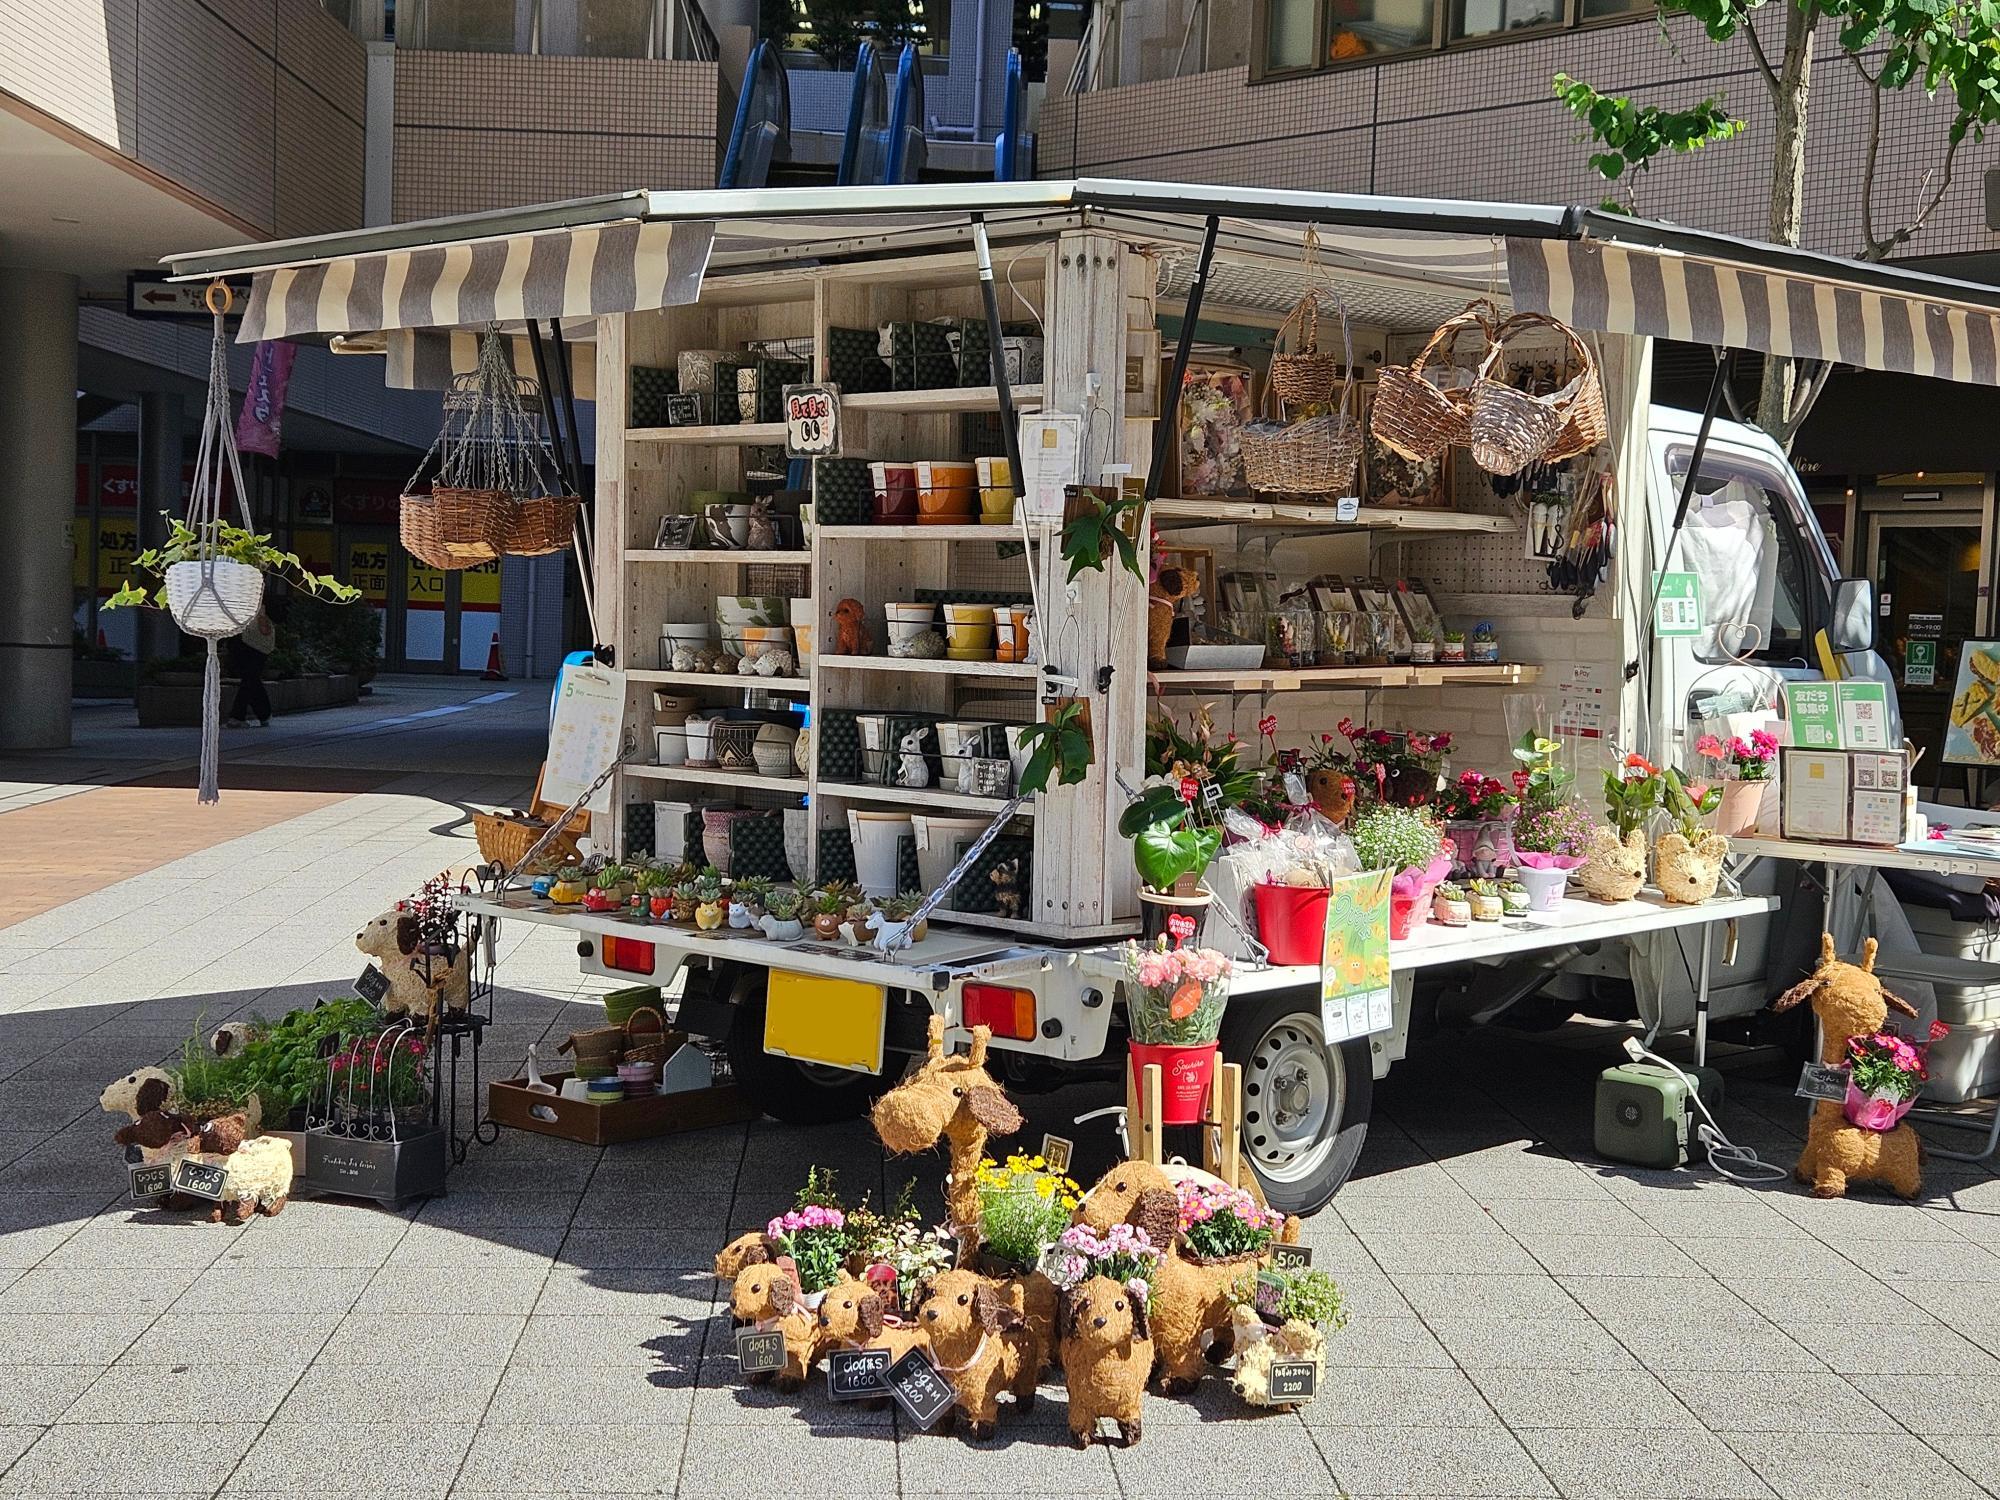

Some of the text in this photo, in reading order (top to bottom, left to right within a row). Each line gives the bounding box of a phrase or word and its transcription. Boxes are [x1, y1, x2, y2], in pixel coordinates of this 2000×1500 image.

[352, 551, 387, 570] 処方
[353, 574, 443, 592] 正面 入口
[1907, 666, 1932, 675] OPEN
[565, 682, 574, 698] 5
[1795, 690, 1828, 702] 友だち
[1796, 702, 1829, 715] 募集中
[143, 1182, 163, 1193] 1600
[187, 1179, 212, 1191] 1600
[1277, 1252, 1305, 1267] 500
[755, 1355, 774, 1367] 1600
[848, 1375, 876, 1387] 1600
[1283, 1382, 1302, 1392] 2200
[898, 1377, 924, 1404] 2400
